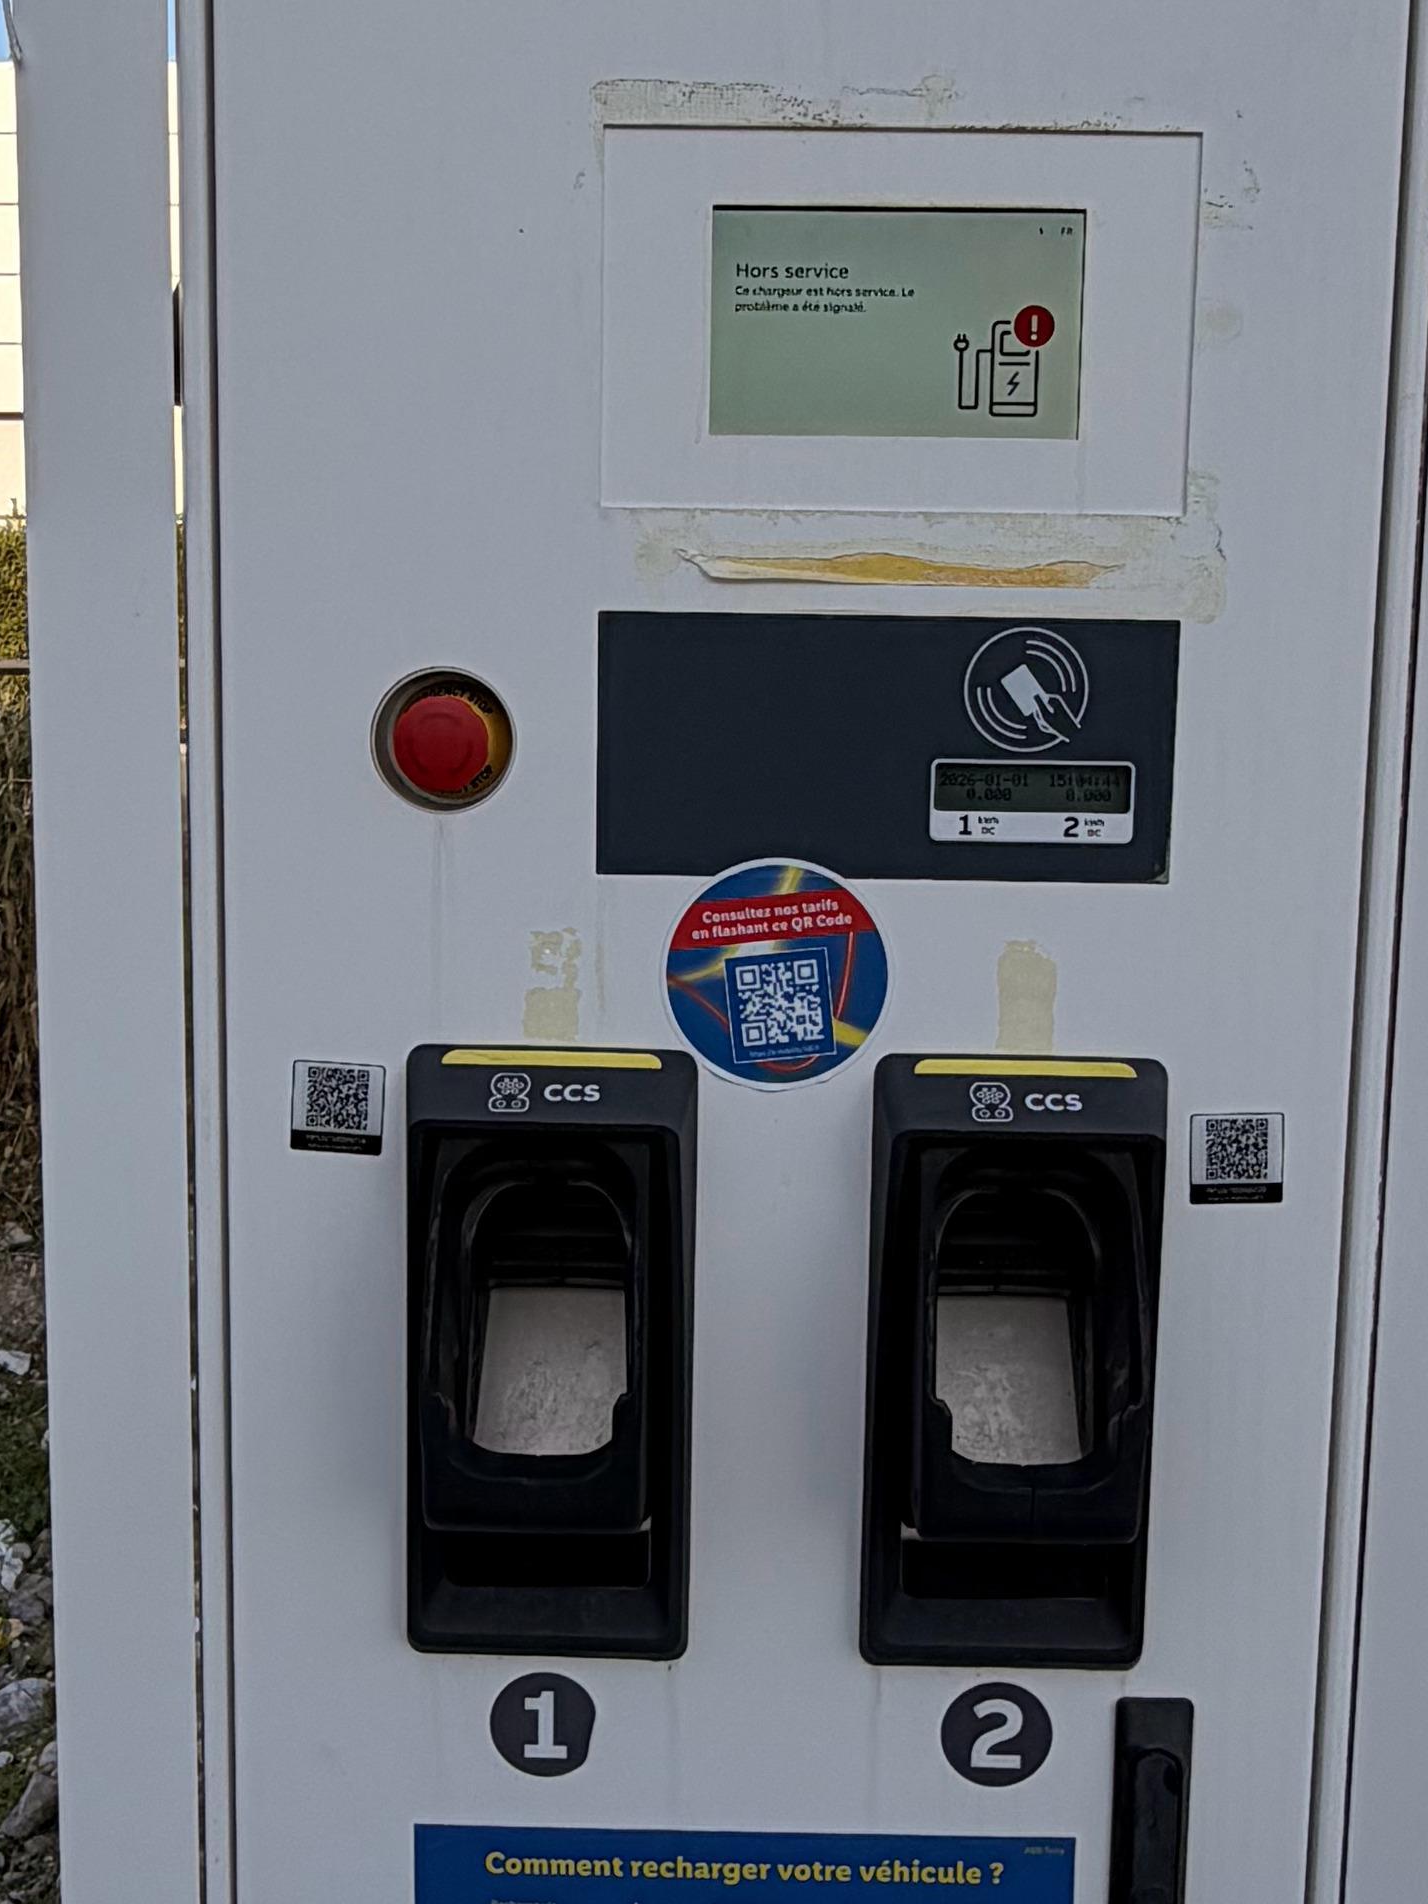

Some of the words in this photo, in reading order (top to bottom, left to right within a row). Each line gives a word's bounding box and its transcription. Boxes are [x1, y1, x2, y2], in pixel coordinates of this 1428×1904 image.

[736, 263, 779, 279] Hors
[785, 263, 849, 279] service
[735, 285, 749, 295] Ce
[752, 286, 803, 298] chargeur
[806, 287, 823, 296] est
[827, 287, 852, 297] hors
[901, 288, 915, 297] Le
[792, 304, 799, 312] a
[959, 814, 972, 836] 1
[981, 827, 995, 835] DC
[1063, 817, 1080, 838] 2
[1087, 829, 1101, 837] DC
[702, 906, 772, 924] Consultez
[774, 905, 799, 917] nos
[802, 899, 839, 914] tarifs
[691, 929, 710, 940] en
[712, 922, 769, 939] flashant
[772, 921, 788, 932] ce
[791, 916, 813, 932] QR
[816, 913, 853, 928] Code
[543, 1083, 601, 1102] CCS
[1025, 1092, 1083, 1112] CCS
[523, 1690, 568, 1759] 1
[971, 1698, 1022, 1769] 2
[484, 1851, 624, 1879] Comment
[631, 1856, 771, 1885] recharger
[777, 1860, 852, 1883] votre
[860, 1859, 983, 1885] véhicule
[989, 1862, 1005, 1885] ?
